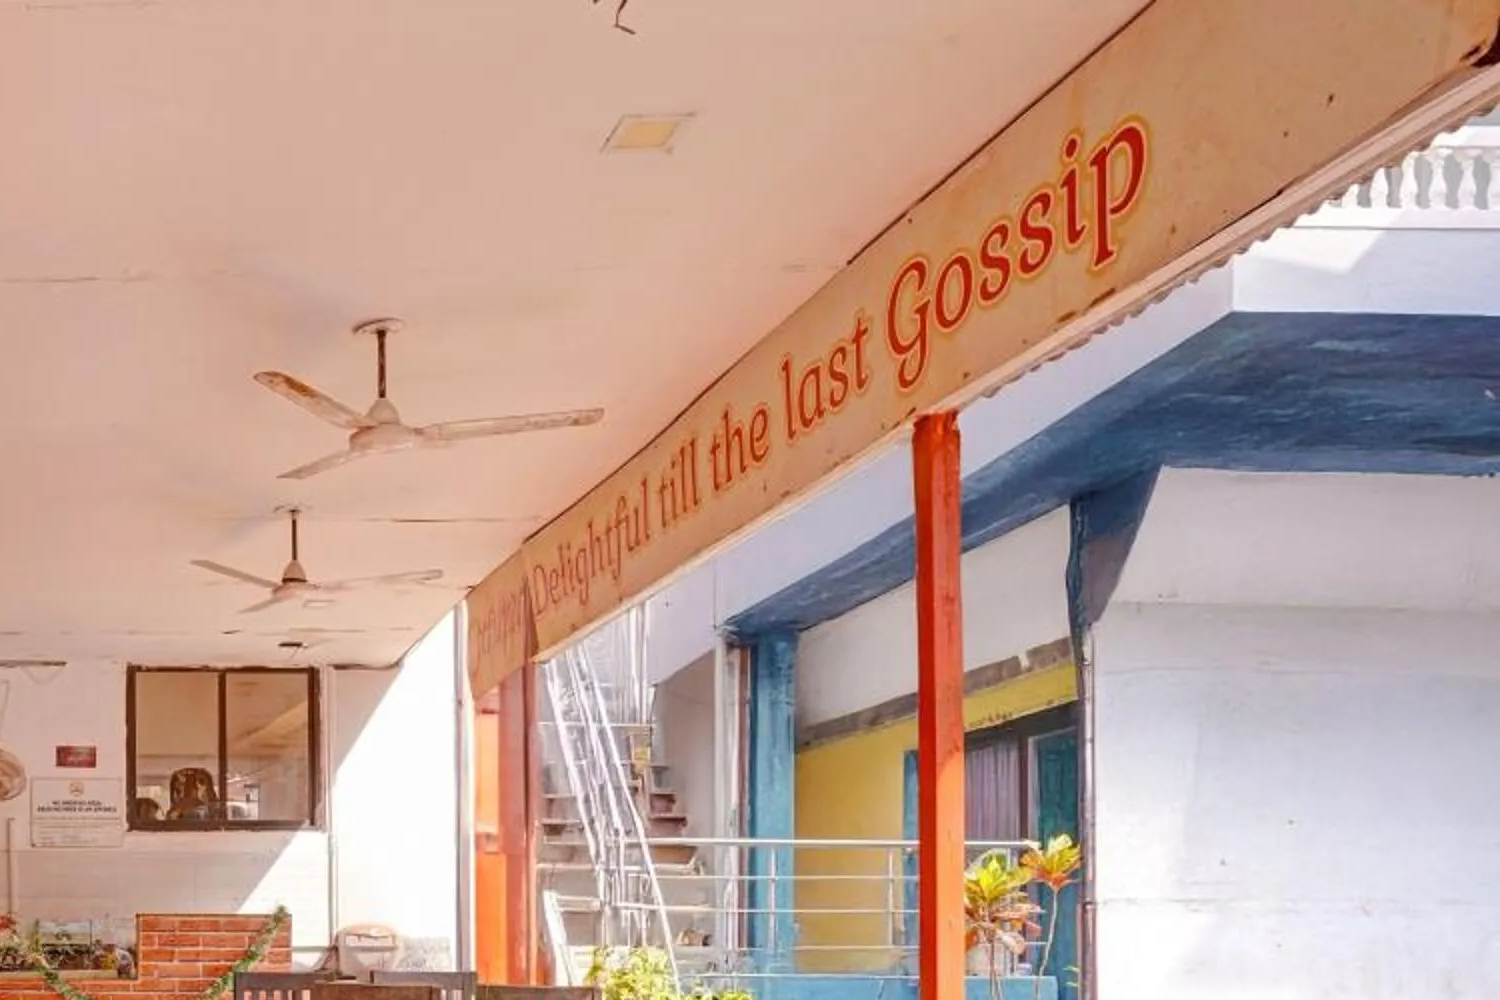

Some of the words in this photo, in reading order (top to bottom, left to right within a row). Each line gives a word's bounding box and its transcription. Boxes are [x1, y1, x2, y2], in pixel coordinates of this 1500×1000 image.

[532, 476, 651, 616] Delightful
[658, 437, 701, 528] till
[709, 407, 770, 491] the
[780, 318, 869, 440] last
[886, 124, 1146, 390] Gossip
